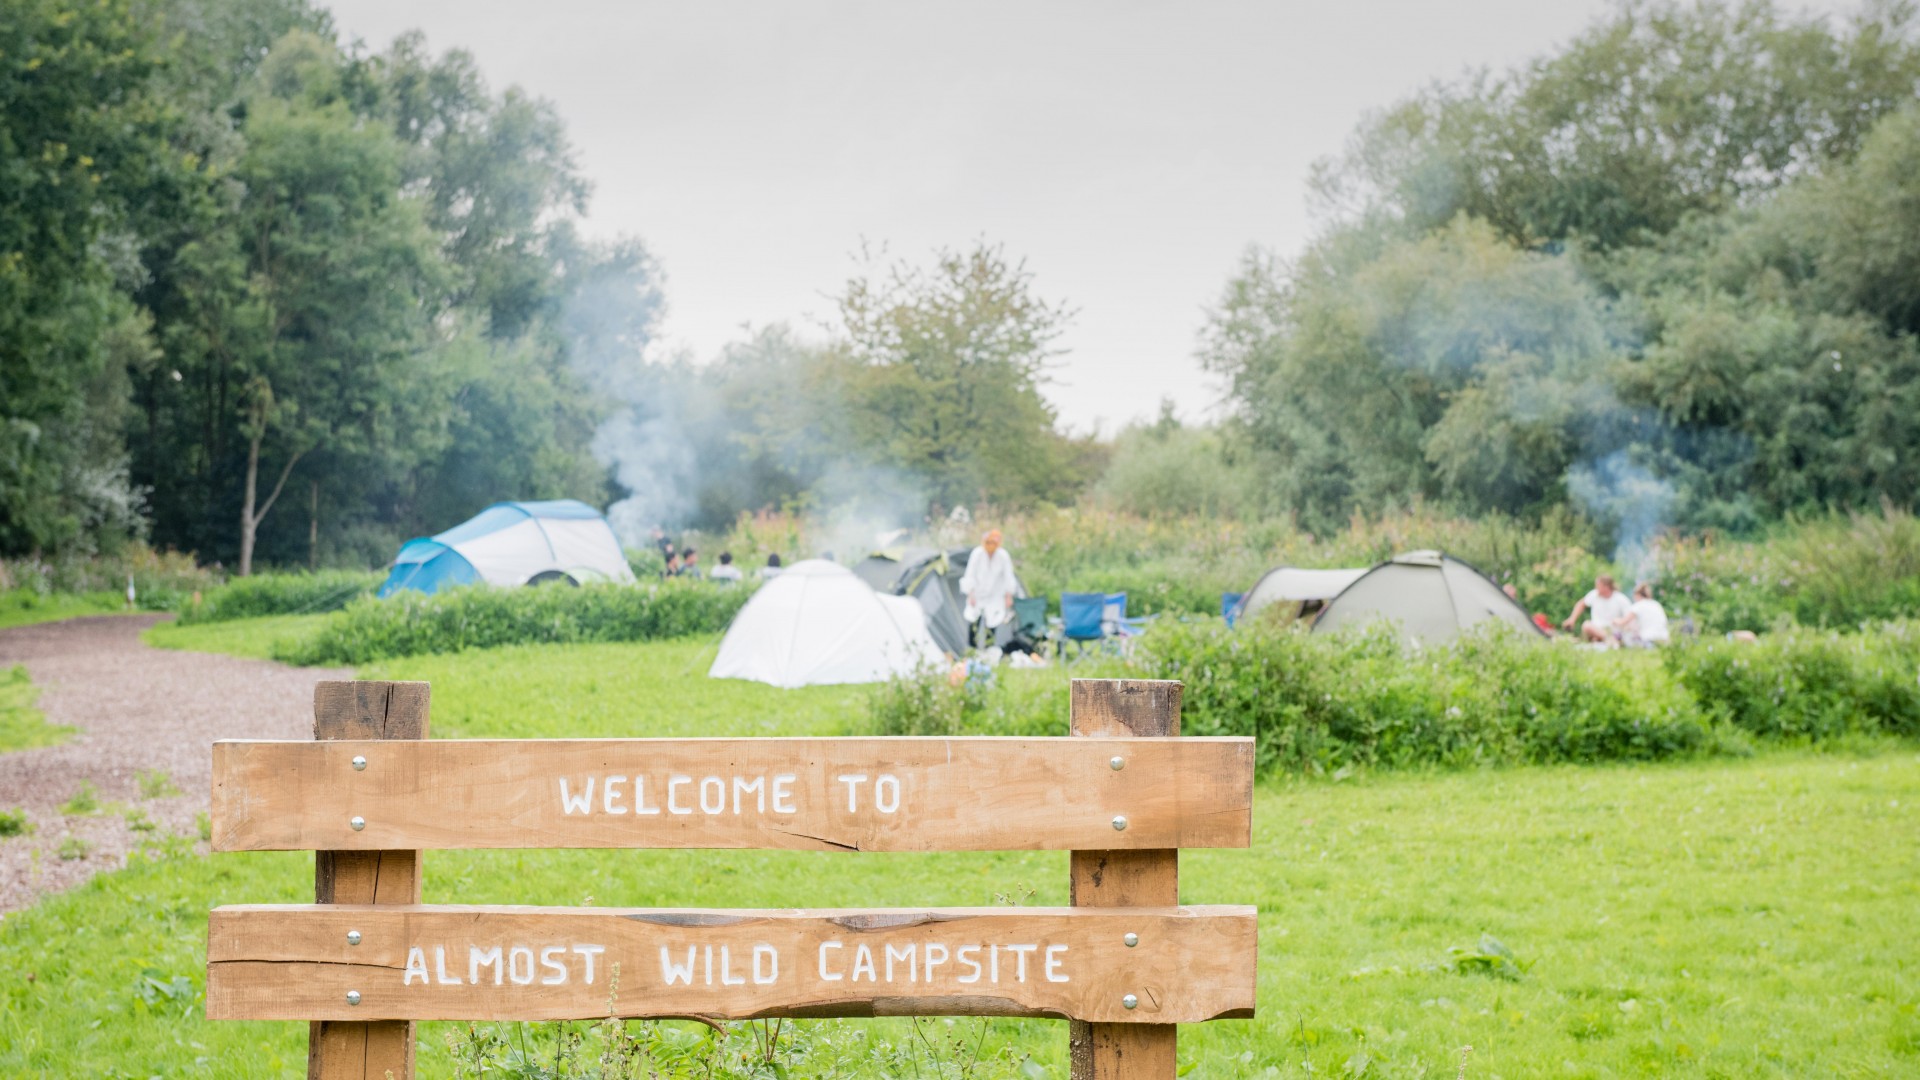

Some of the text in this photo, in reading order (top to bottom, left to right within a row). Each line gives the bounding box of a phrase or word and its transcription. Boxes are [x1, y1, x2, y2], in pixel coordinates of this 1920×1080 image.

[558, 772, 902, 816] WELCOME TO
[403, 940, 1071, 987] ALMOST WILD CAMPSITE
